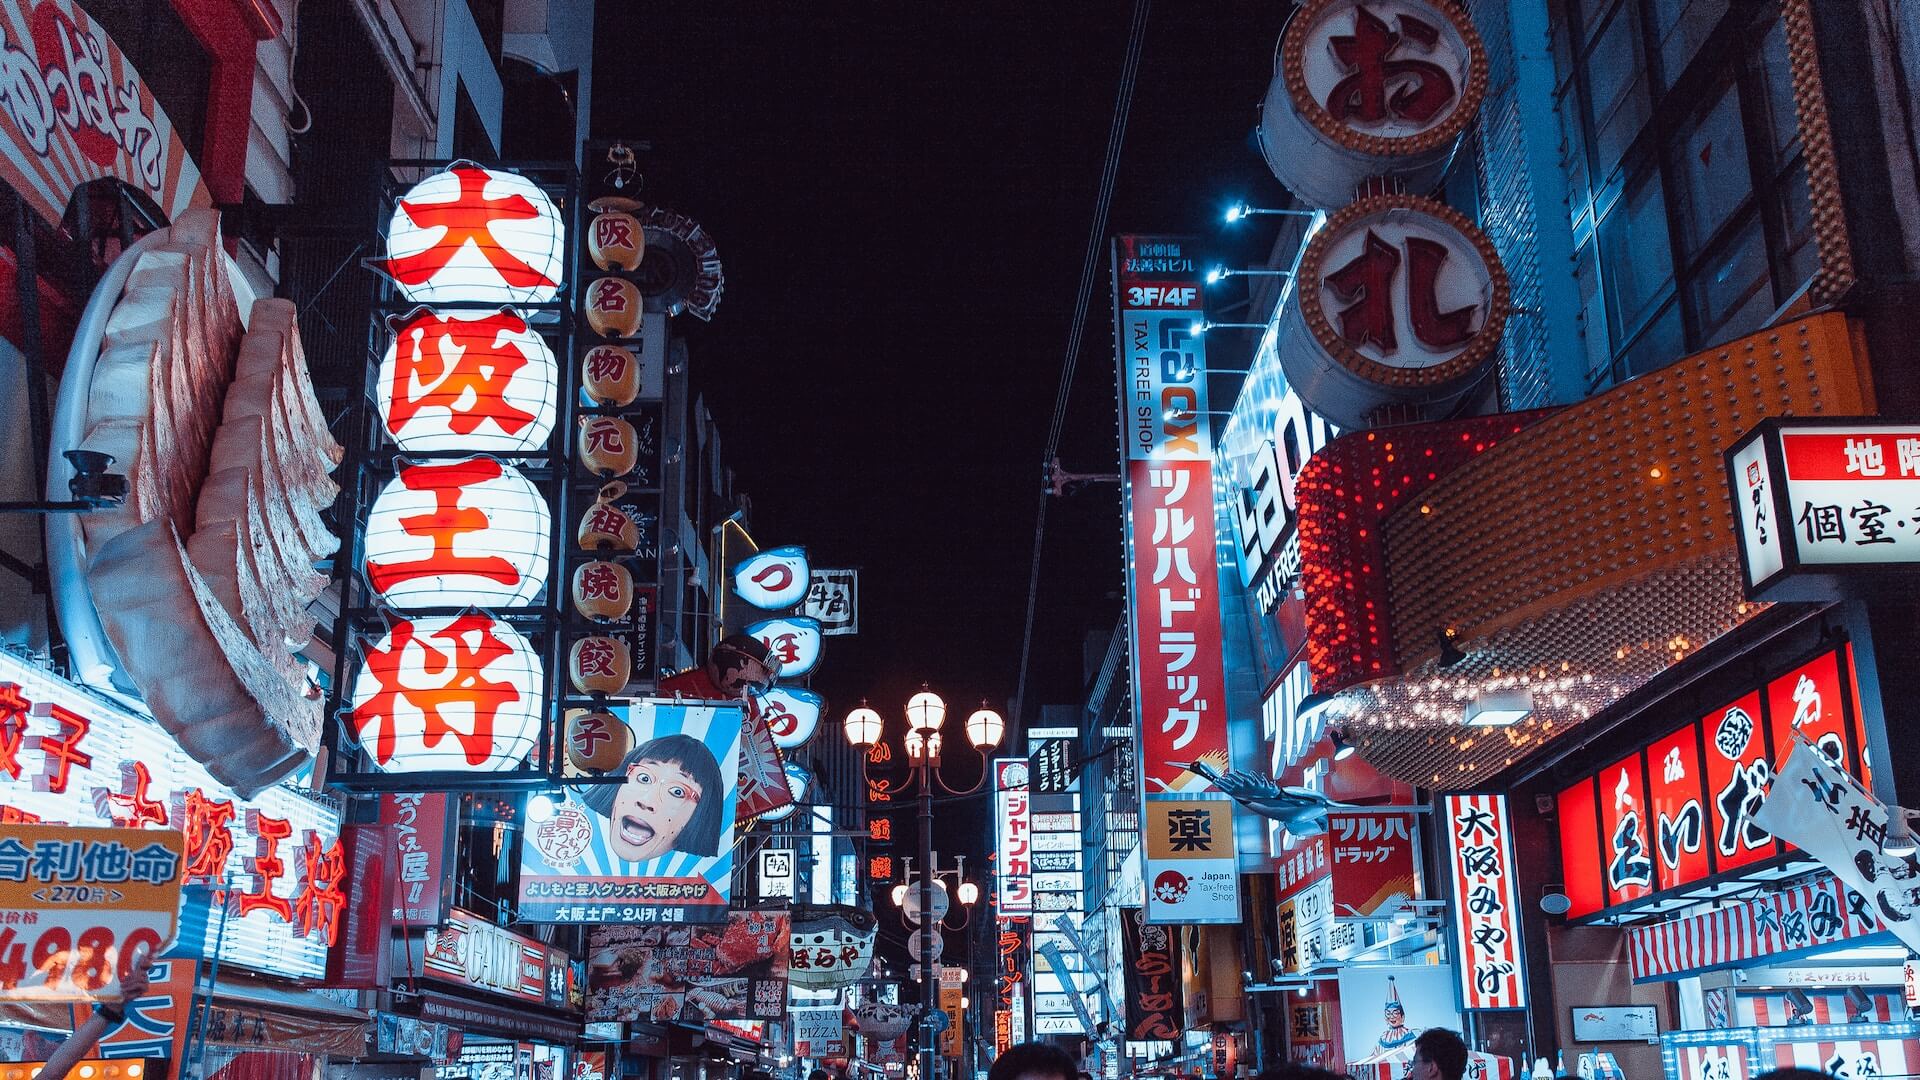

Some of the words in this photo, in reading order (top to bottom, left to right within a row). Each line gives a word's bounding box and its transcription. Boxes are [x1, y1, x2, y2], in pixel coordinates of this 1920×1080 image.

[1128, 287, 1197, 306] 3F/4F
[1133, 319, 1149, 352] TAX
[1135, 356, 1151, 401] FREE
[1137, 407, 1153, 454] SHOP
[340, 164, 559, 766] 大阪王将
[1149, 469, 1208, 751] ツルハドラッグ
[1256, 583, 1278, 617] TAX
[1168, 809, 1212, 852] 薬
[1332, 817, 1409, 841] ツルハ
[1008, 795, 1030, 902] ジャンカラ
[1334, 846, 1395, 864] ドラッグ
[526, 882, 707, 898] よしもと芸人グッズ・大阪みやげ
[1198, 883, 1234, 892] Tax-free
[1201, 872, 1233, 882] Japan.
[1211, 892, 1234, 902] Shop
[1301, 893, 1319, 920] くすり
[1457, 807, 1513, 995] 大阪みやげ
[1134, 952, 1181, 1040] らーめん
[799, 1027, 840, 1038] PIZZA
[1044, 1020, 1073, 1029] ZAZA
